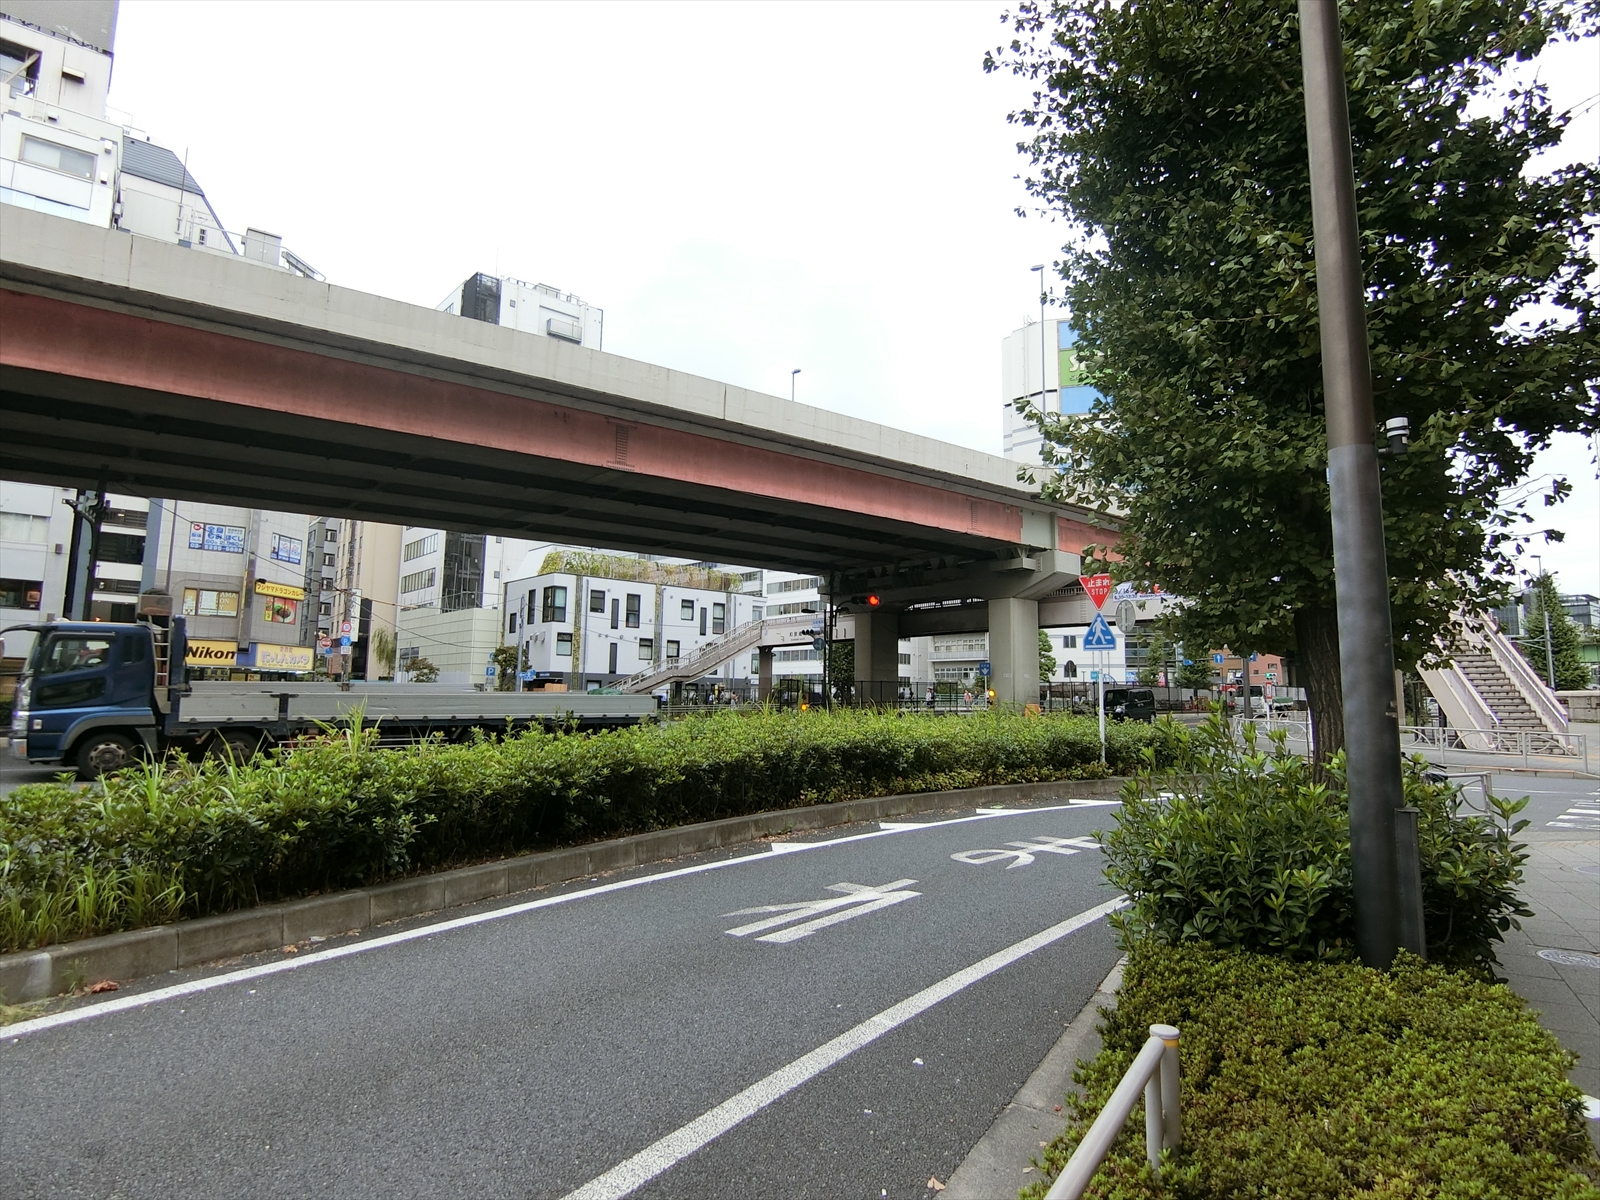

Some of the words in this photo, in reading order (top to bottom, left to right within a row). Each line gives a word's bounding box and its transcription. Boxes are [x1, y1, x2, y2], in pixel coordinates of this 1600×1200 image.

[1087, 578, 1111, 588] 止まれ
[256, 583, 305, 597] フジヤマドラゴンカレー
[1091, 587, 1108, 596] STOP
[186, 645, 237, 660] Nikon
